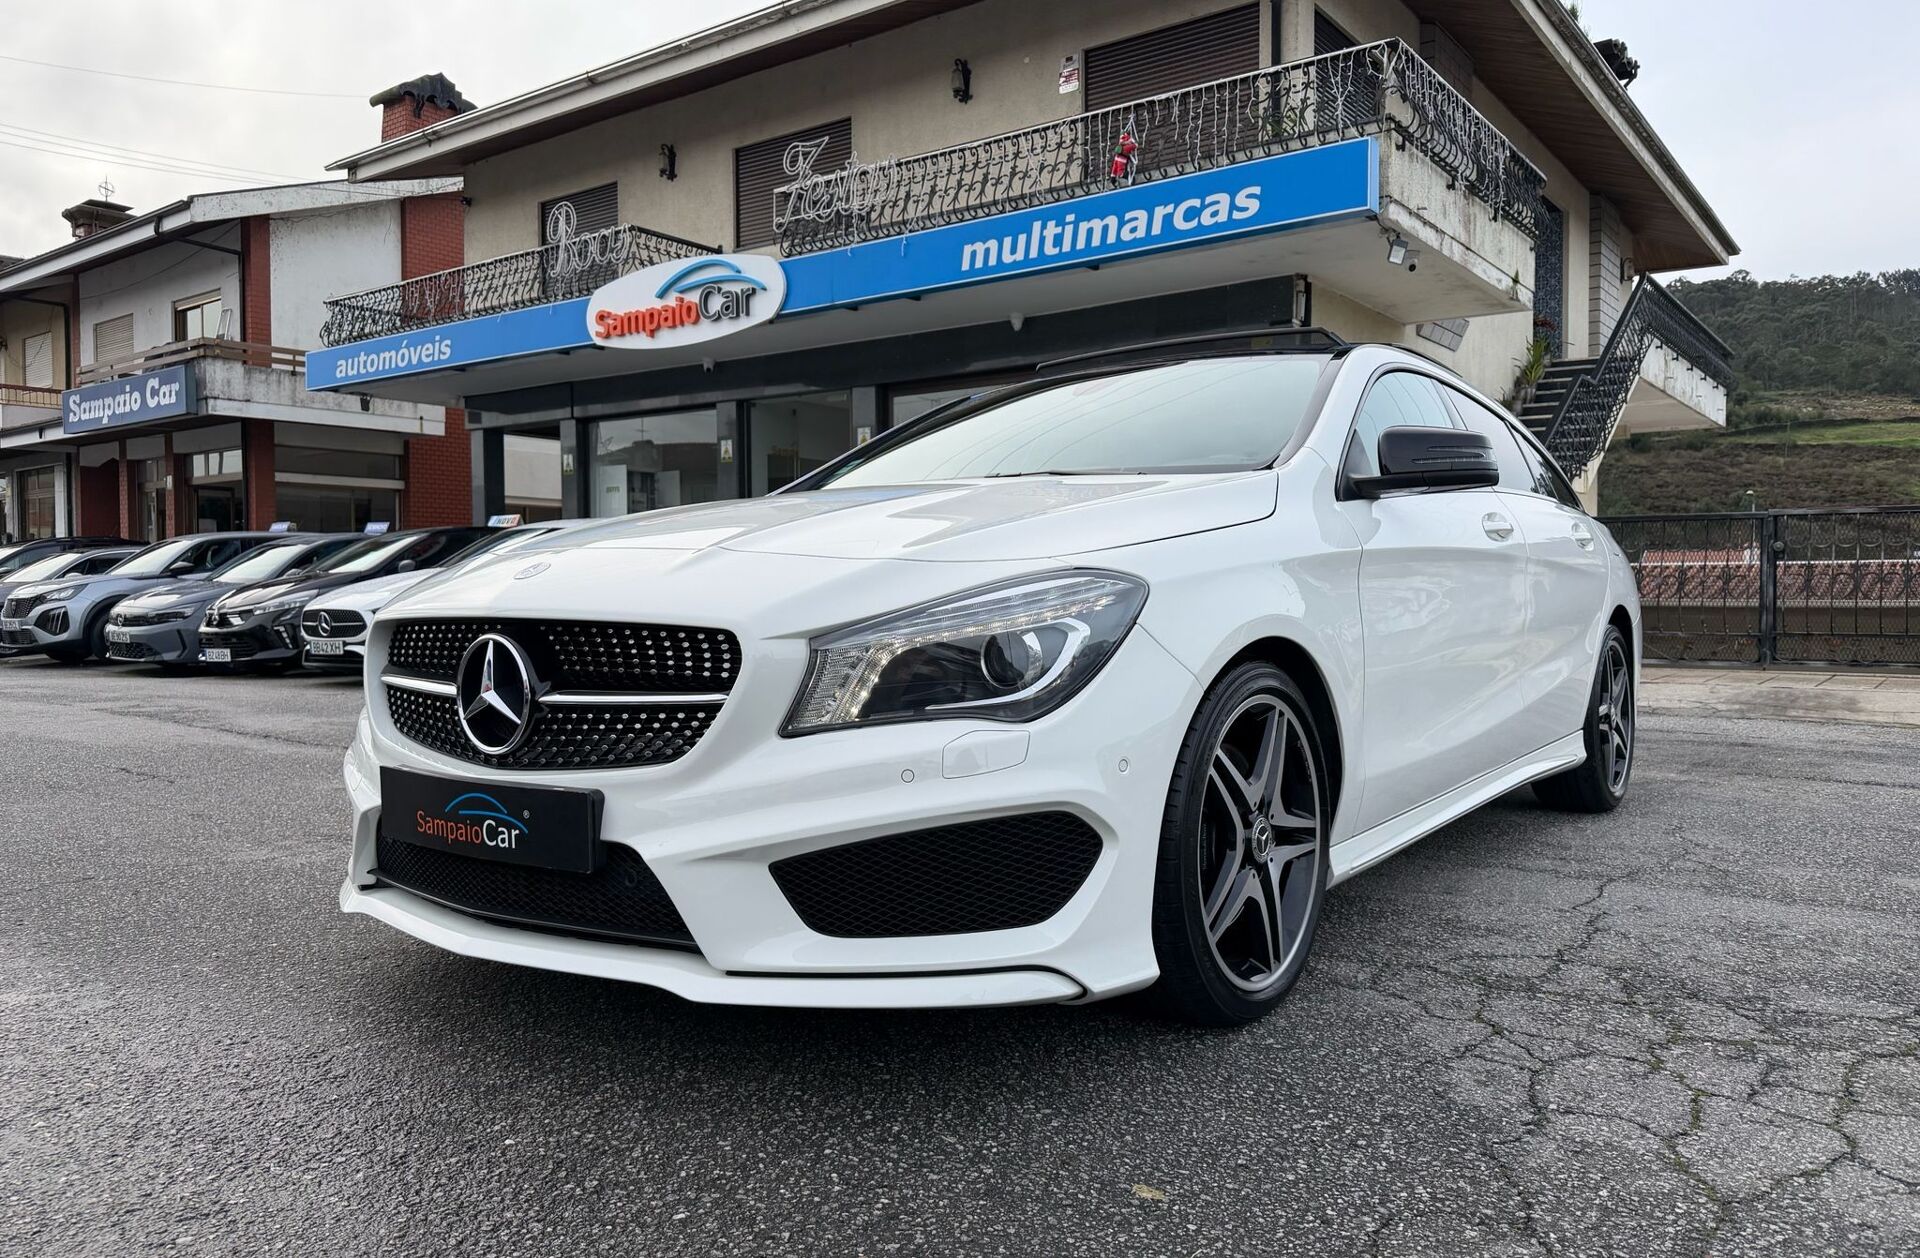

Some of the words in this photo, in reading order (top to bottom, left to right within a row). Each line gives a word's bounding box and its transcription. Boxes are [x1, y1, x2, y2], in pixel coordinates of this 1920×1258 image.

[961, 186, 1262, 272] multimarcas
[595, 283, 757, 338] SampaioCar
[335, 335, 452, 378] automóveis
[69, 385, 141, 424] Sampaio
[146, 377, 180, 408] Car
[416, 810, 520, 849] SampaioCar
